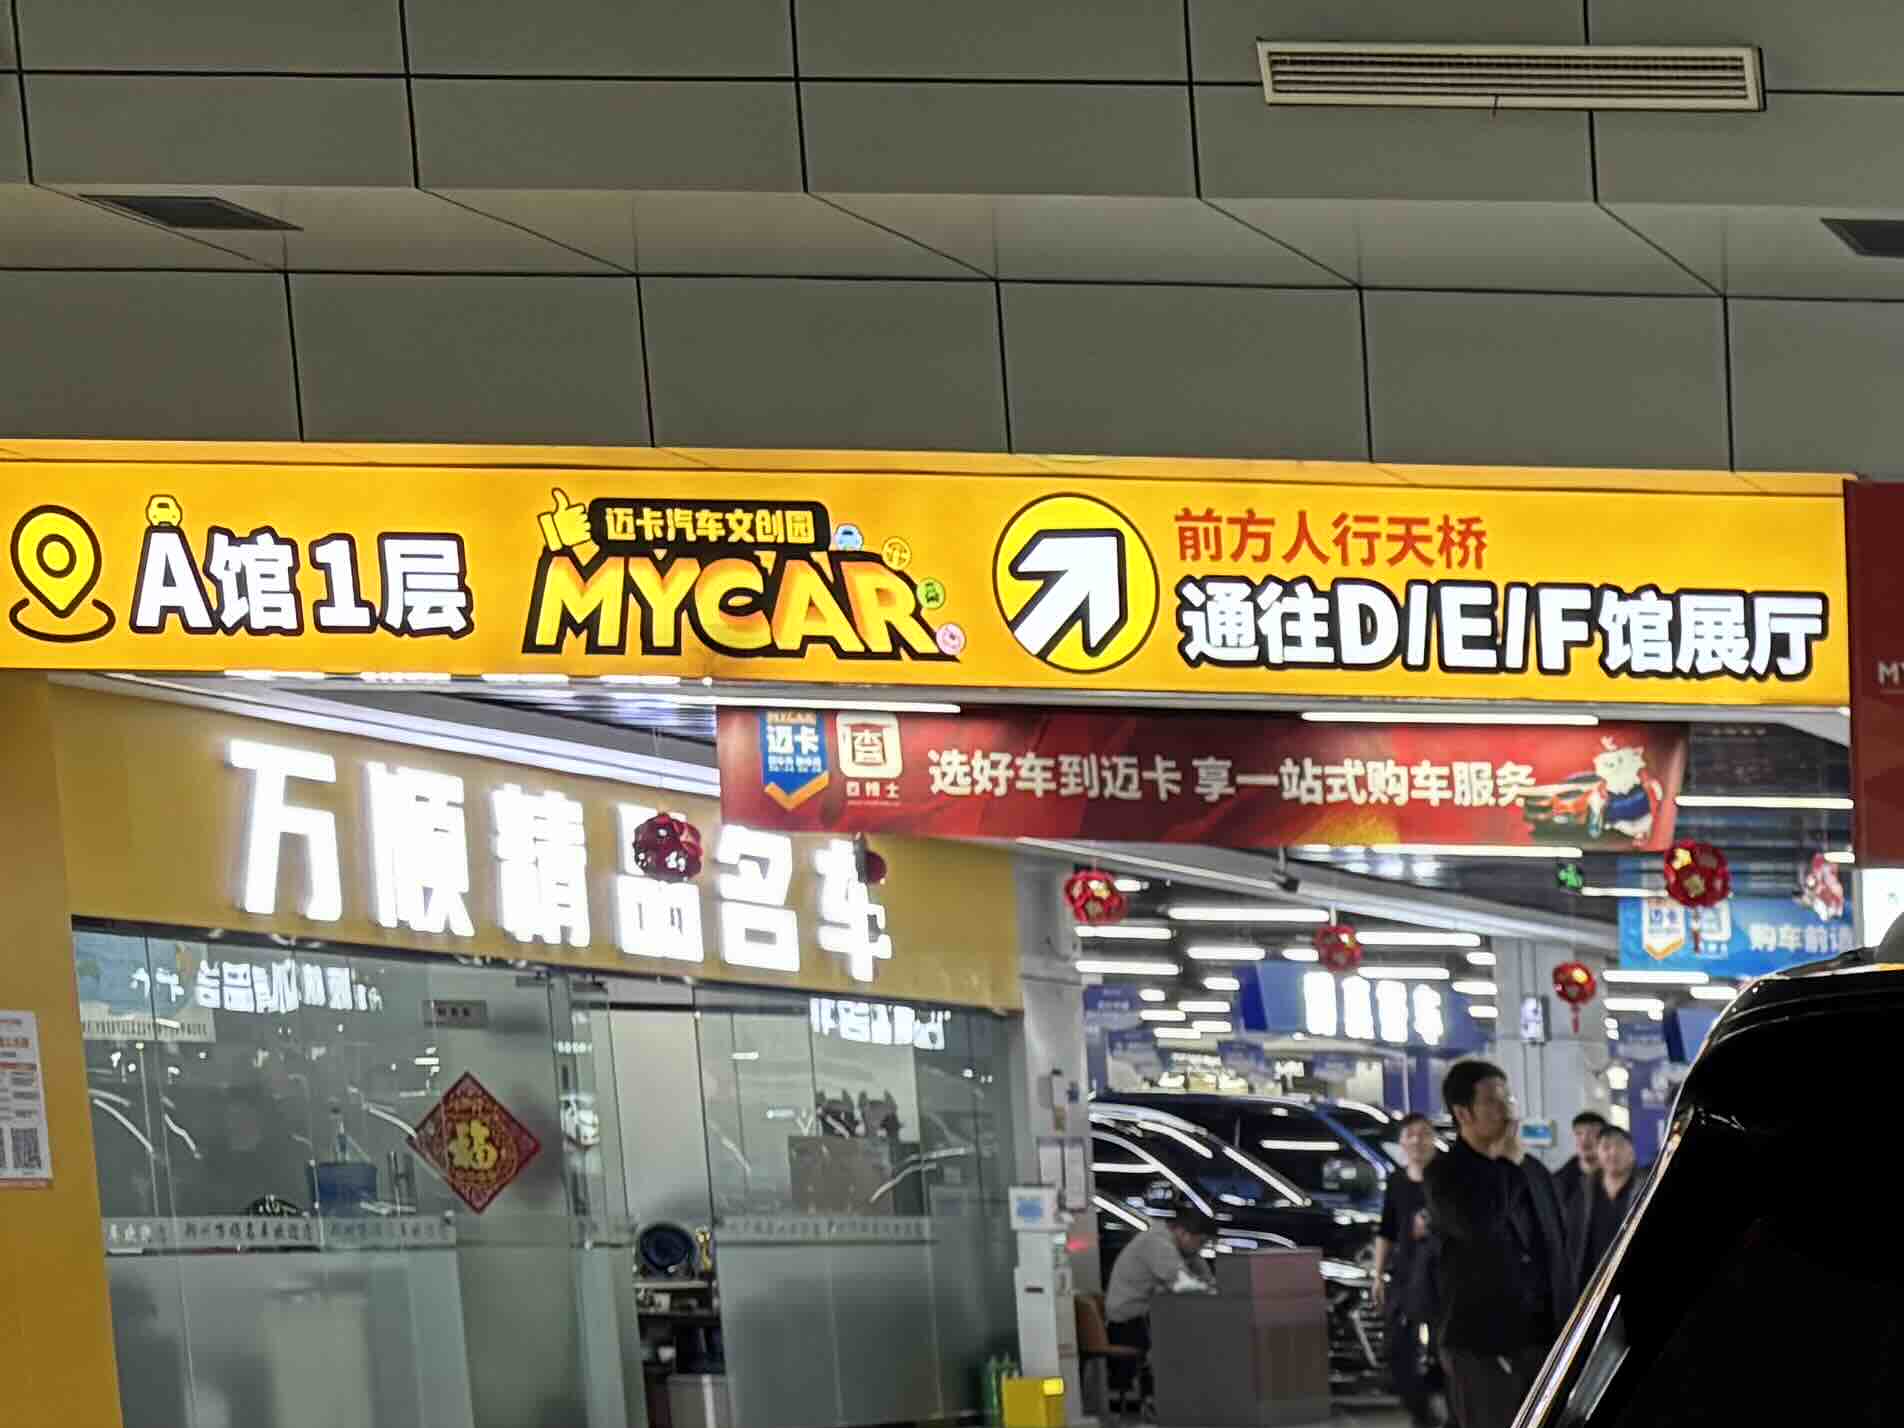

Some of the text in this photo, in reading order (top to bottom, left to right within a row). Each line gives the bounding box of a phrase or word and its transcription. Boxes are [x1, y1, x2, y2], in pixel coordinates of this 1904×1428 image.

[605, 507, 815, 545] 迈卡汽车文创园
[1174, 509, 1489, 570] 前方人行天桥
[135, 528, 473, 635] A馆1层
[528, 552, 948, 660] MYCAR
[1177, 576, 1827, 677] 通往D/E/F馆展厅
[928, 748, 1536, 808] 选好车到迈卡 享一站式购车服务
